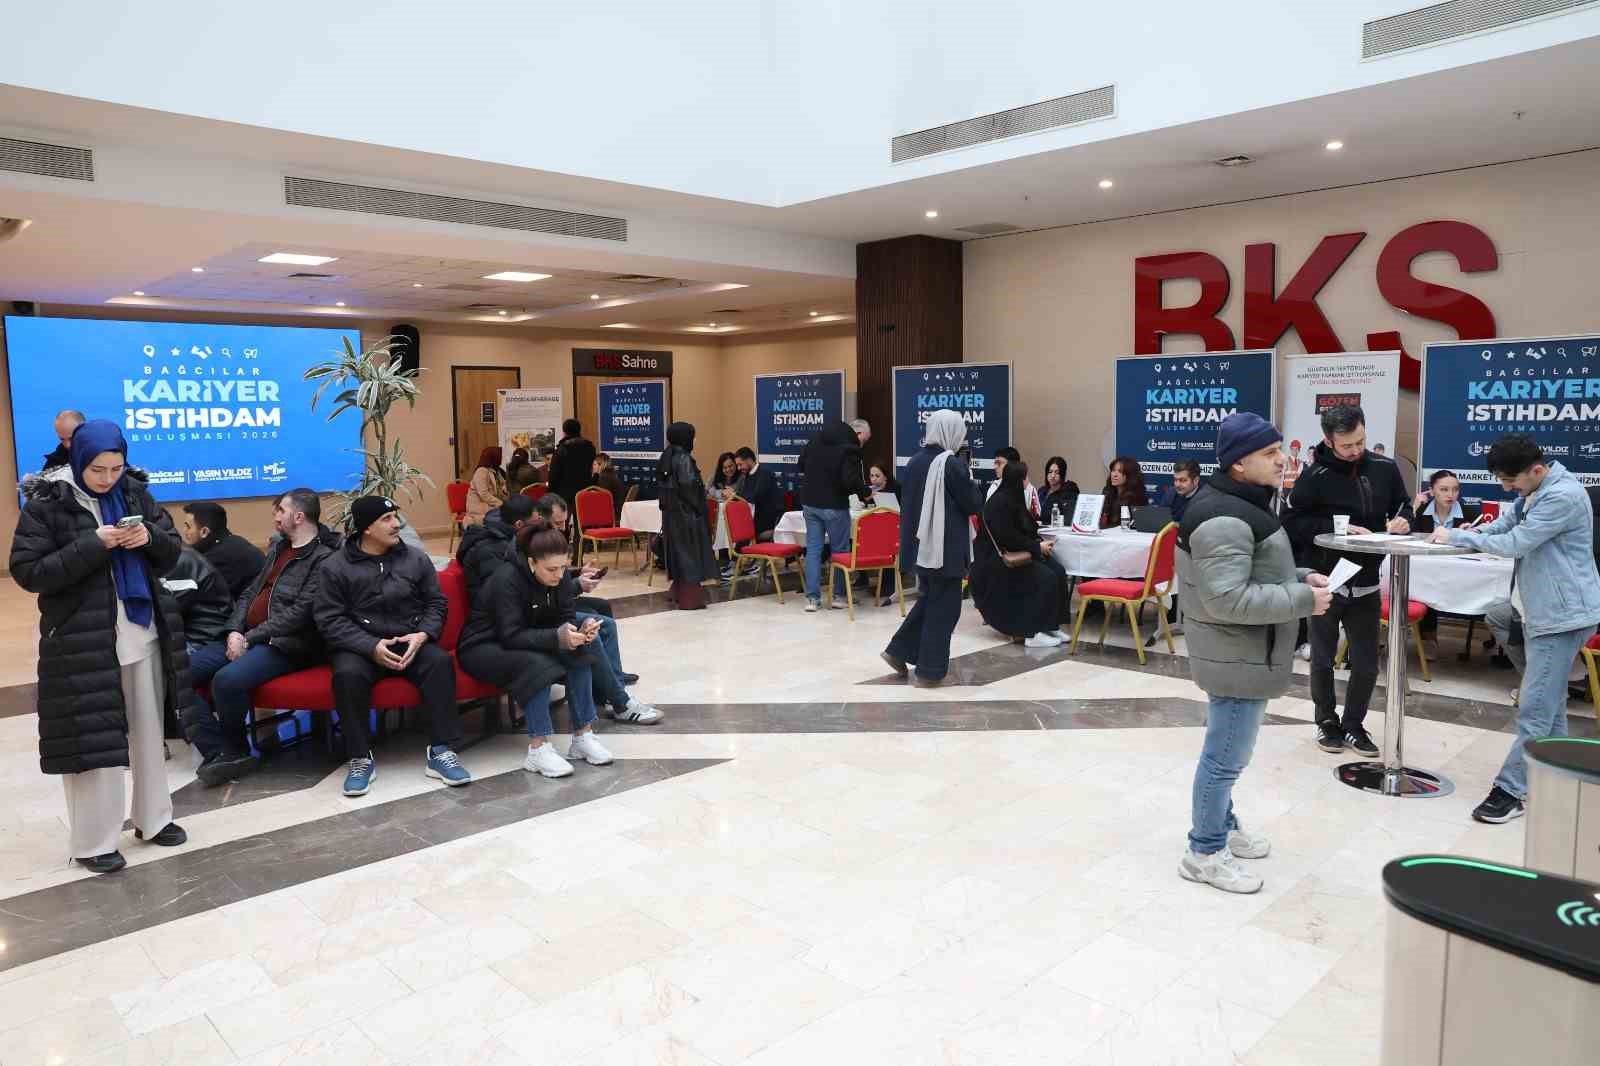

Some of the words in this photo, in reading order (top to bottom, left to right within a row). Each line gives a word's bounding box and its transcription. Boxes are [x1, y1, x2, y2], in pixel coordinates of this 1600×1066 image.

[1135, 220, 1498, 393] BKS
[144, 365, 262, 376] BAĞCILAR
[1486, 367, 1592, 377] BAĞCILAR
[123, 379, 280, 402] KARİYER
[1146, 388, 1238, 404] KARİYER
[773, 399, 824, 411] KARİYER
[917, 394, 984, 407] KARİYER
[125, 408, 280, 429] İSTİHDAM
[773, 414, 824, 425] İSTİHDAM
